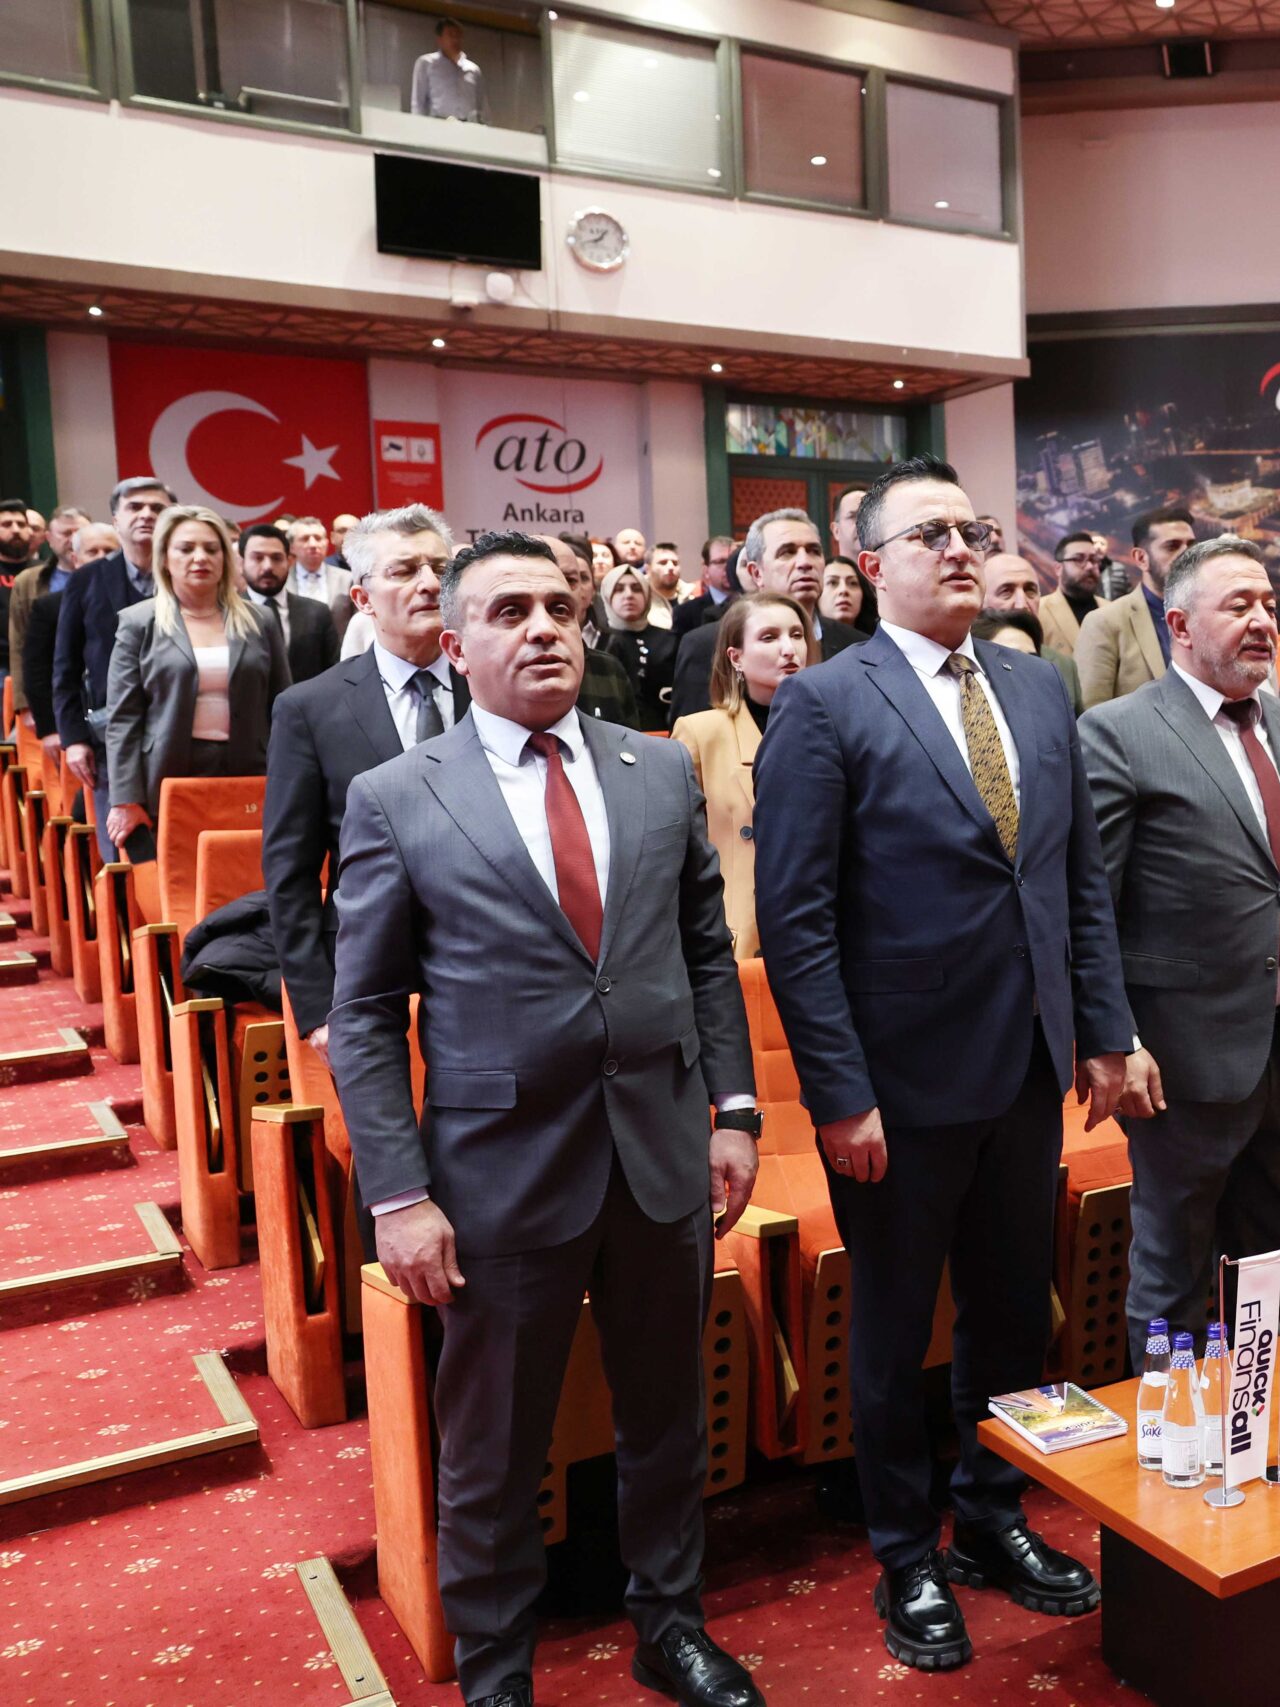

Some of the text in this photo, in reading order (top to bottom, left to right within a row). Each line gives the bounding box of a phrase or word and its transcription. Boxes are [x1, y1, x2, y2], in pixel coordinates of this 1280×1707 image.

[493, 428, 587, 474] ato
[503, 502, 584, 523] Ankara
[1230, 1300, 1261, 1456] Finansall
[1251, 1329, 1273, 1407] QUICK
